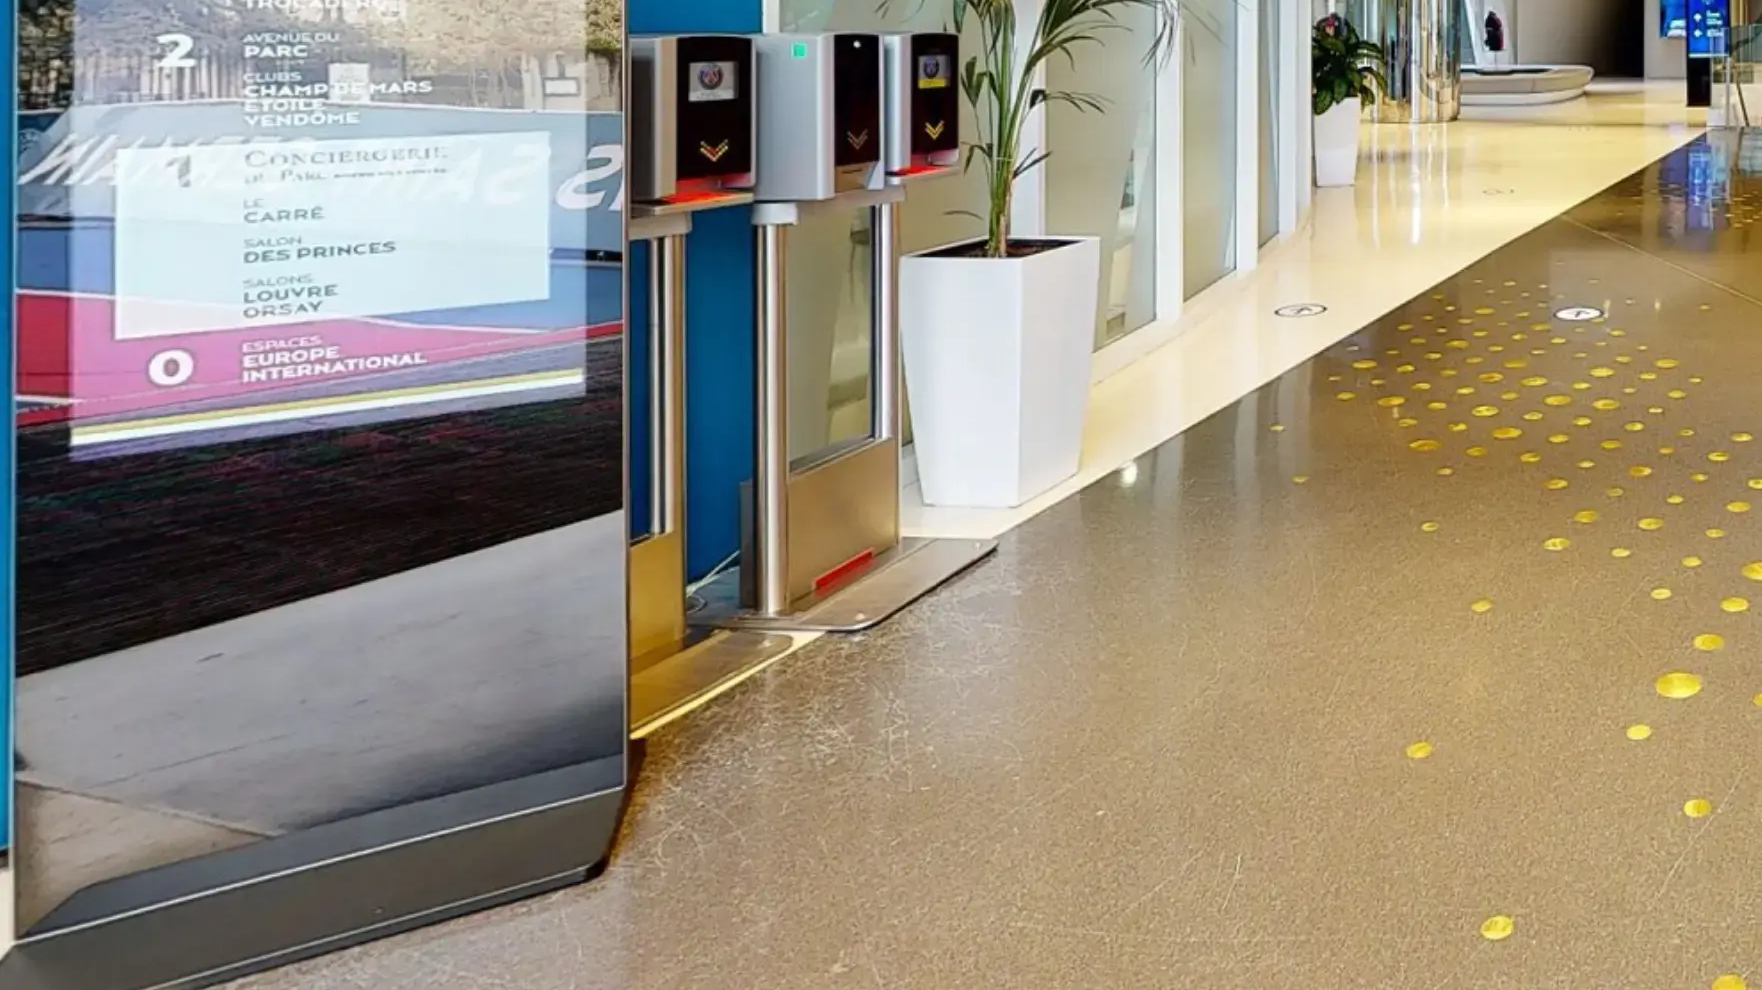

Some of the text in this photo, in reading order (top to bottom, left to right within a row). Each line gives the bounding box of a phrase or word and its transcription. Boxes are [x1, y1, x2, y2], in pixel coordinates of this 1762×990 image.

[243, 33, 309, 44] AVENUE
[156, 34, 197, 68] 2
[244, 44, 308, 58] PARC
[243, 72, 302, 83] CLUBS
[243, 83, 329, 97] CHAMP
[369, 82, 433, 94] MARS
[244, 112, 360, 128] VENDÔME
[243, 206, 325, 224] CARRÉ
[243, 236, 302, 249] SALON
[243, 241, 397, 264] DES PRINCES
[243, 274, 313, 288] SALONS
[243, 284, 339, 304] LOUVRE
[243, 301, 323, 319] ORSAY
[242, 335, 322, 353] ESPACES
[243, 346, 340, 368] EUROPE
[149, 349, 193, 385] 0
[243, 353, 427, 383] INTERNATIONAL
